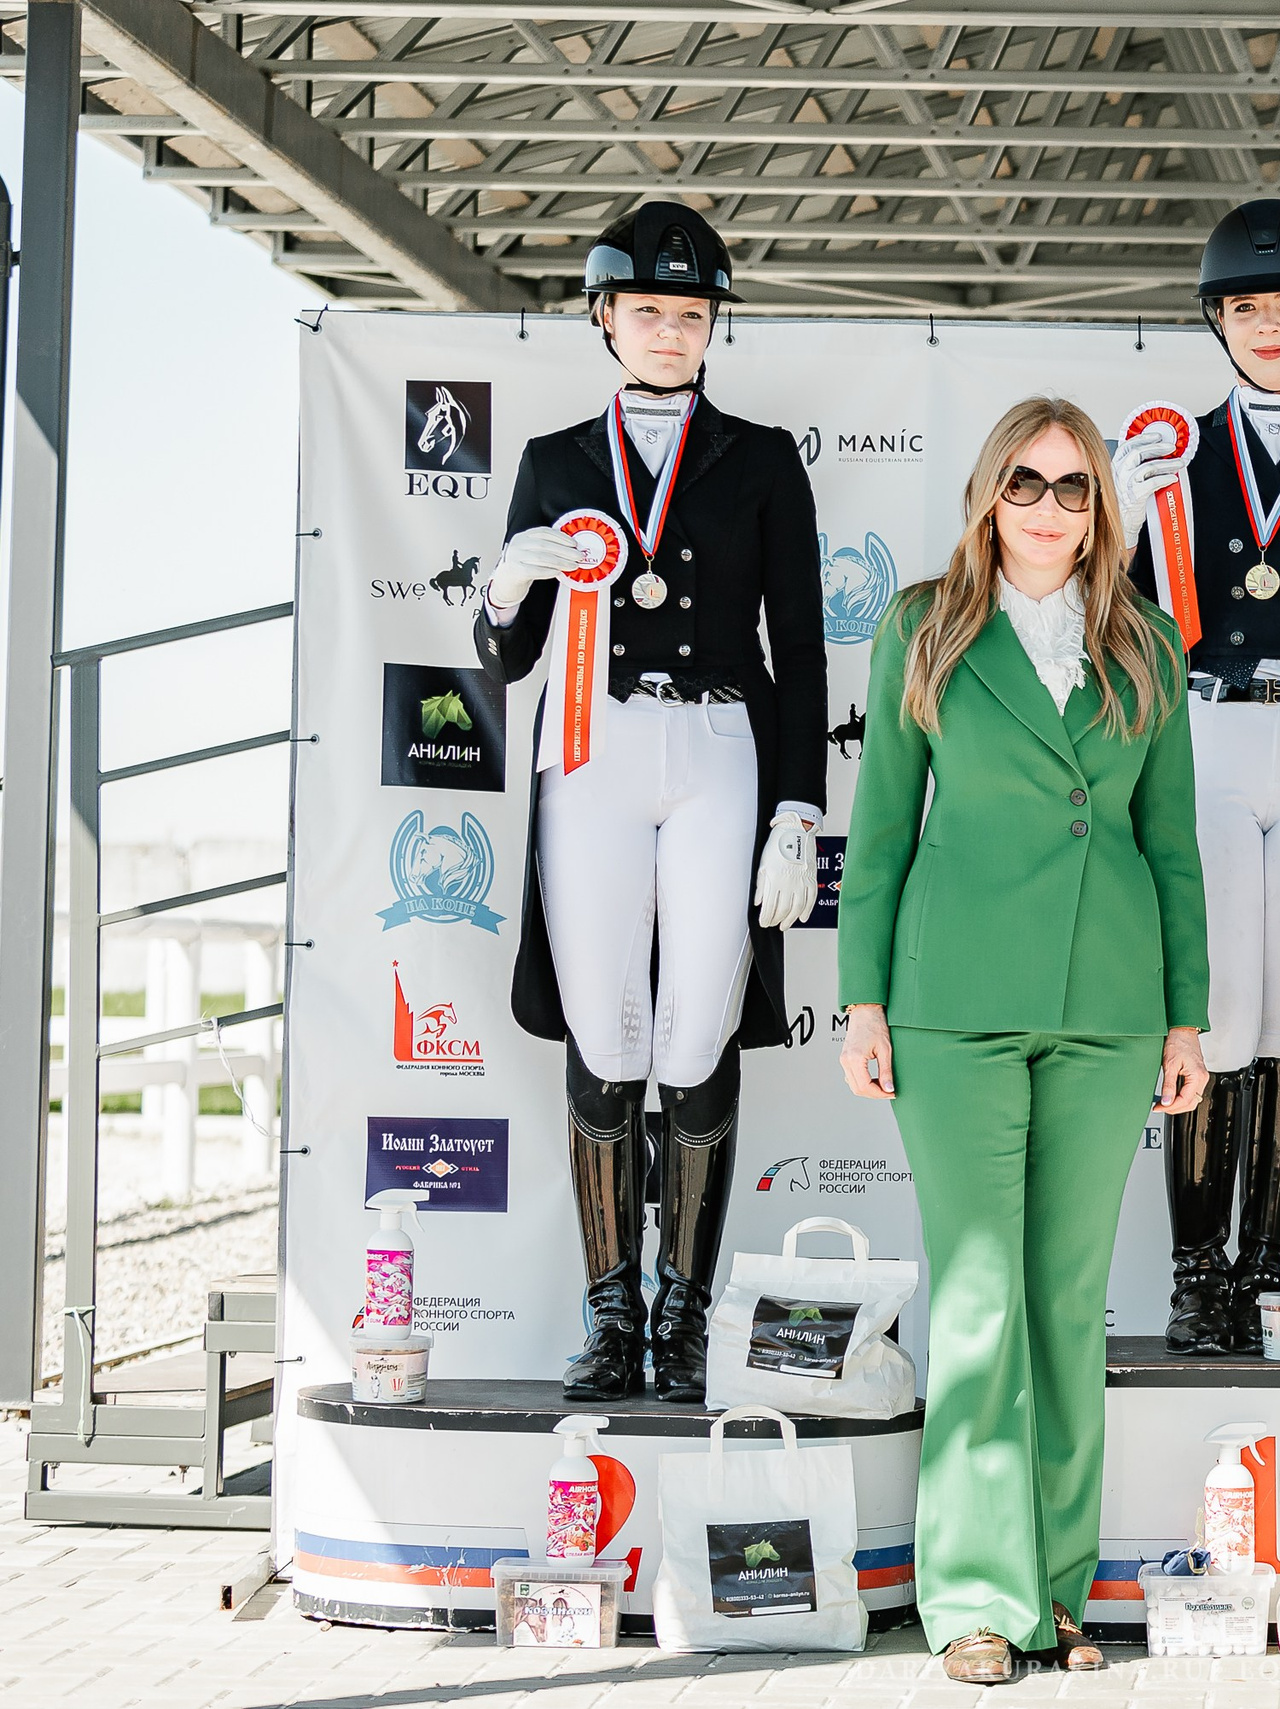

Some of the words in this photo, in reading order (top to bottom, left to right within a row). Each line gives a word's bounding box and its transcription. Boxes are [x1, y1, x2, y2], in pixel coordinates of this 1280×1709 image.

[838, 428, 924, 453] MANÍC
[405, 473, 492, 500] EQU
[1174, 532, 1182, 544] ПО
[1176, 543, 1188, 586] МОСКВЫ
[577, 651, 586, 664] ПО
[575, 665, 585, 704] МОСКВЫ
[407, 742, 481, 762] АНИЛИН
[405, 898, 428, 914] НА
[431, 897, 477, 917] КОНЕ
[416, 1039, 481, 1056] ФКСМ
[819, 1159, 887, 1171] ФЕДЕРАЦИЯ
[819, 1172, 874, 1182] КОННОГО
[876, 1172, 914, 1182] СПОРТ
[412, 1181, 449, 1189] ФАБРИКА
[819, 1184, 866, 1194] РОССИИ
[413, 1297, 481, 1308] ФЕДЕРАЦИЯ
[413, 1309, 468, 1320] КОННОГО
[470, 1310, 515, 1320] СПОРТА
[413, 1321, 460, 1331] РОССИИ
[776, 1327, 825, 1345] АНИЛИН
[738, 1567, 788, 1581] АНИЛИН
